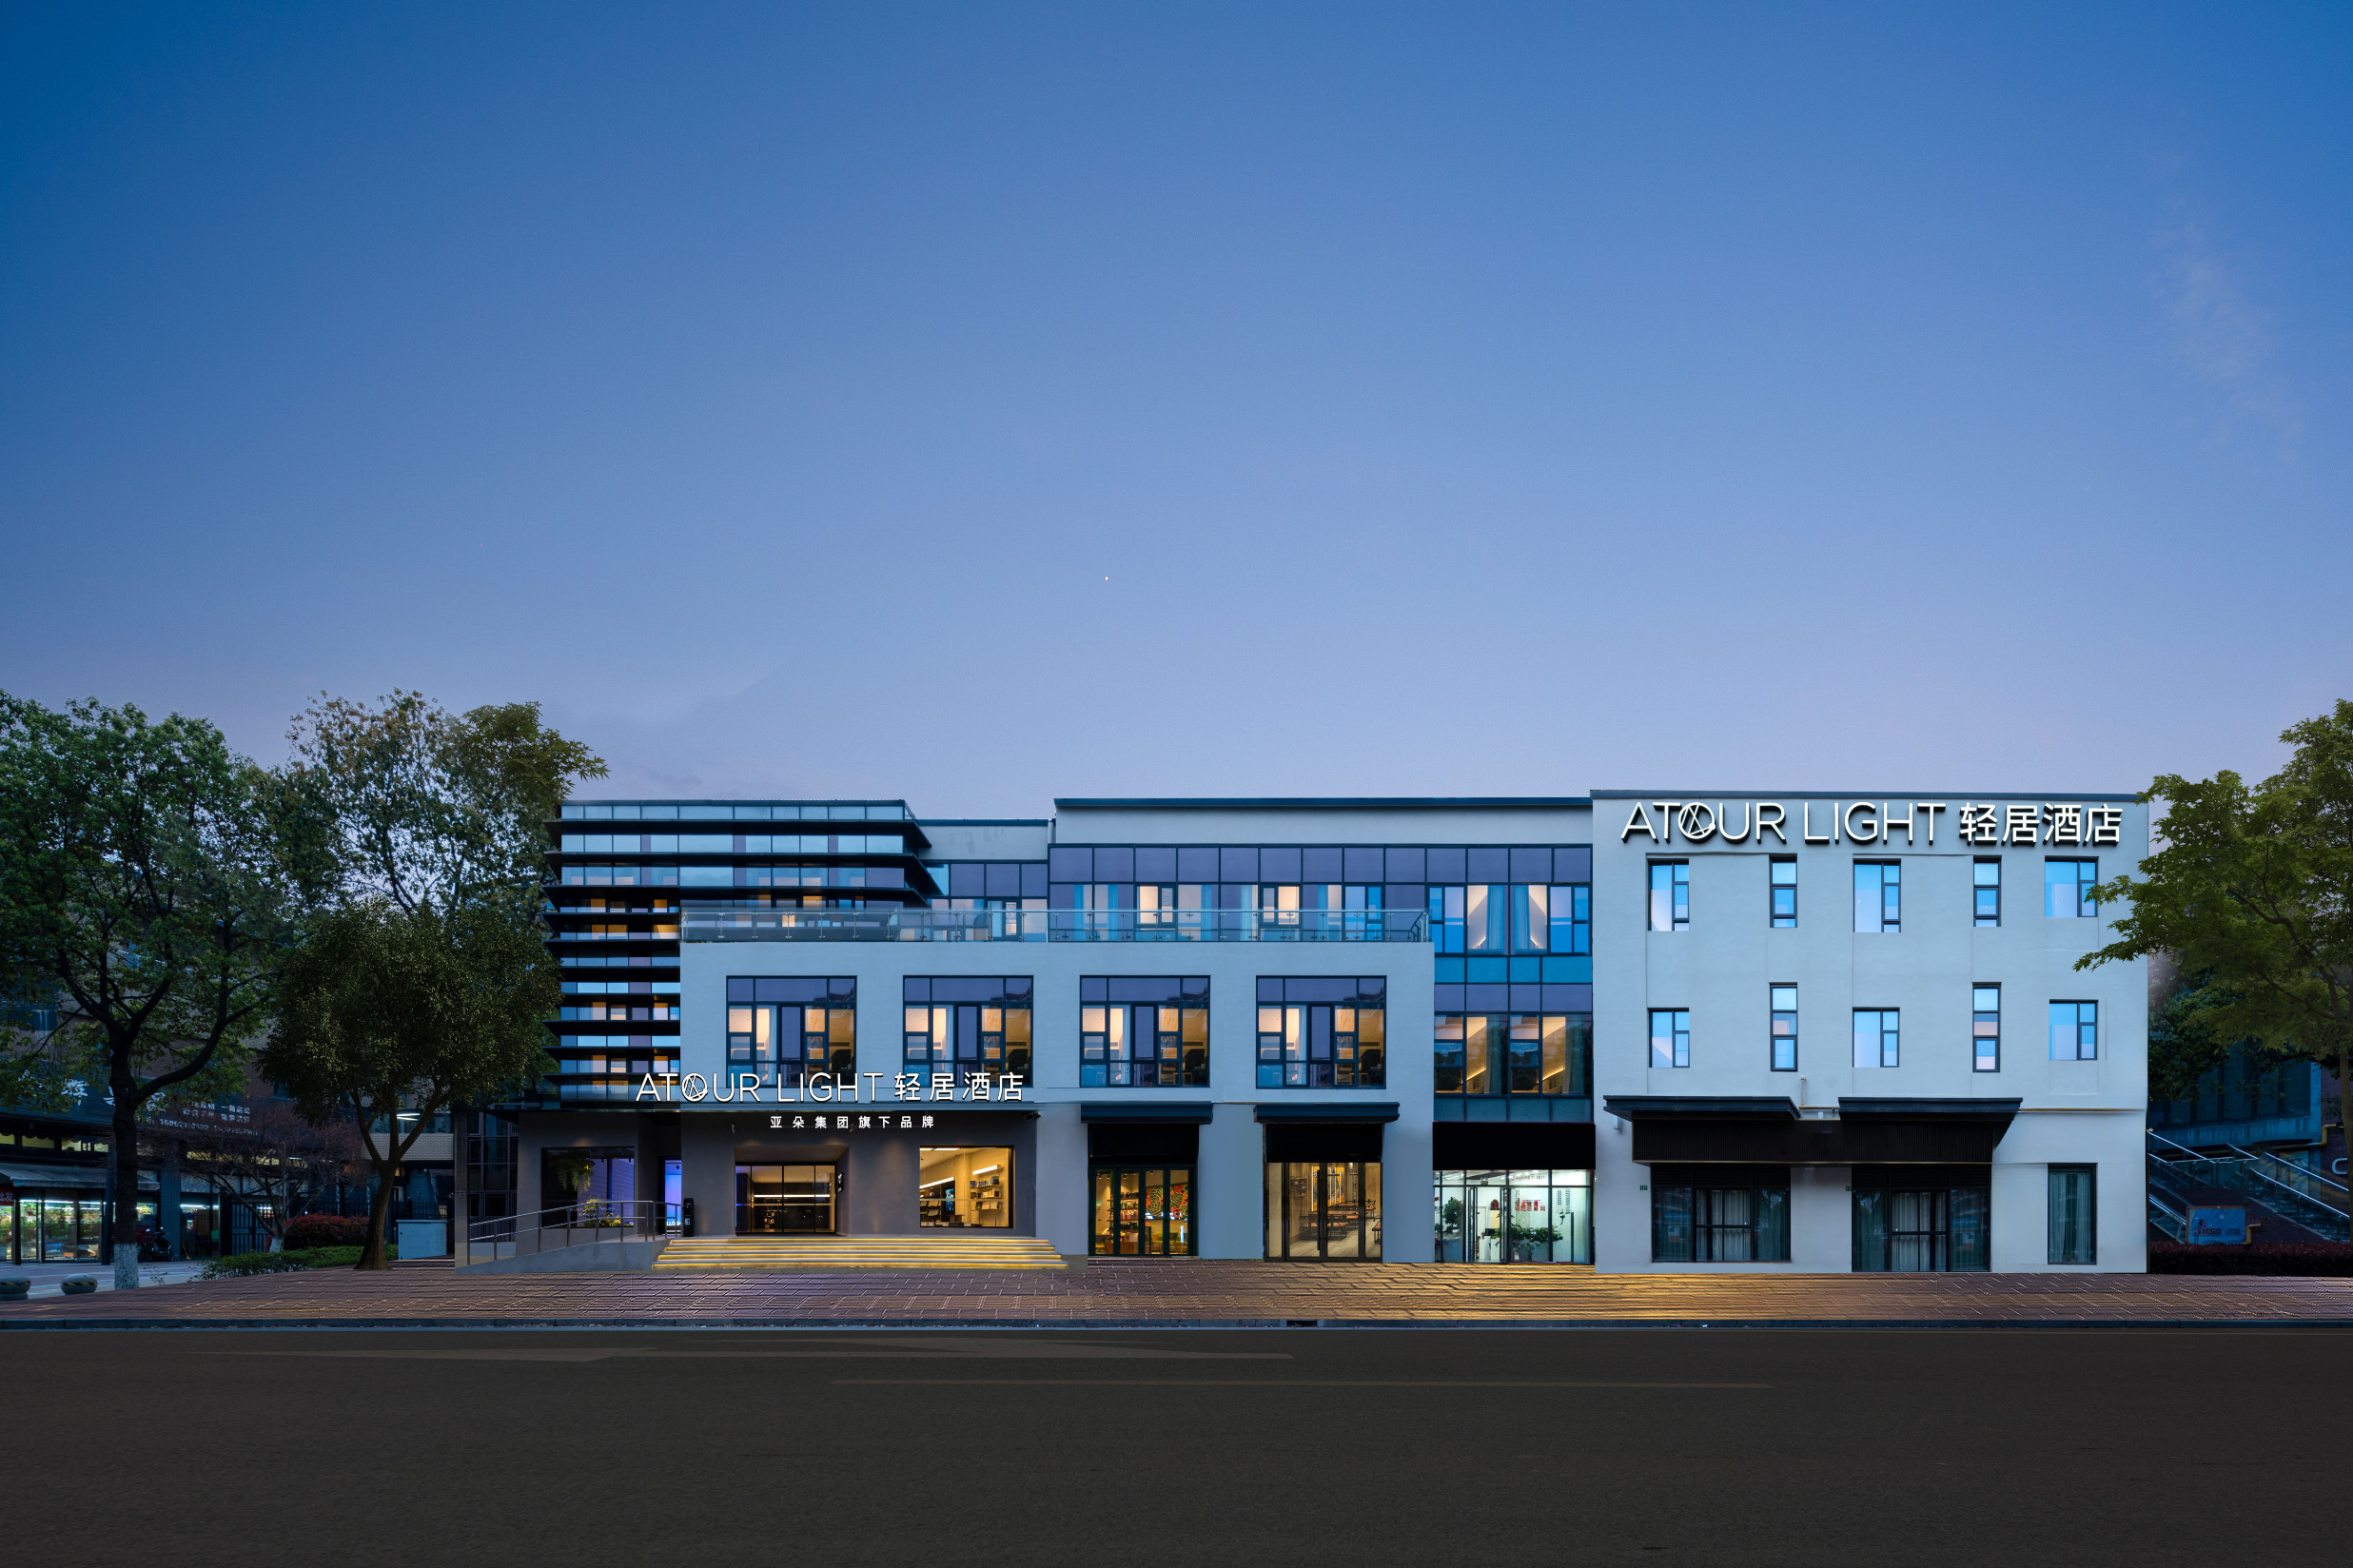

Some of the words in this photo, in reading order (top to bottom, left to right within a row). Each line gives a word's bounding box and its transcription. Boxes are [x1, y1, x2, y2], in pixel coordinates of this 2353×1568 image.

[1620, 801, 1787, 844] ATOUR
[1804, 801, 1946, 845] LIGHT
[1959, 802, 2124, 846] 轻居酒店
[636, 1071, 760, 1102] ATOUR
[776, 1071, 883, 1102] LIGHT
[893, 1071, 1024, 1102] 轻居酒店
[770, 1115, 934, 1129] 亚朵集团旗下品牌
